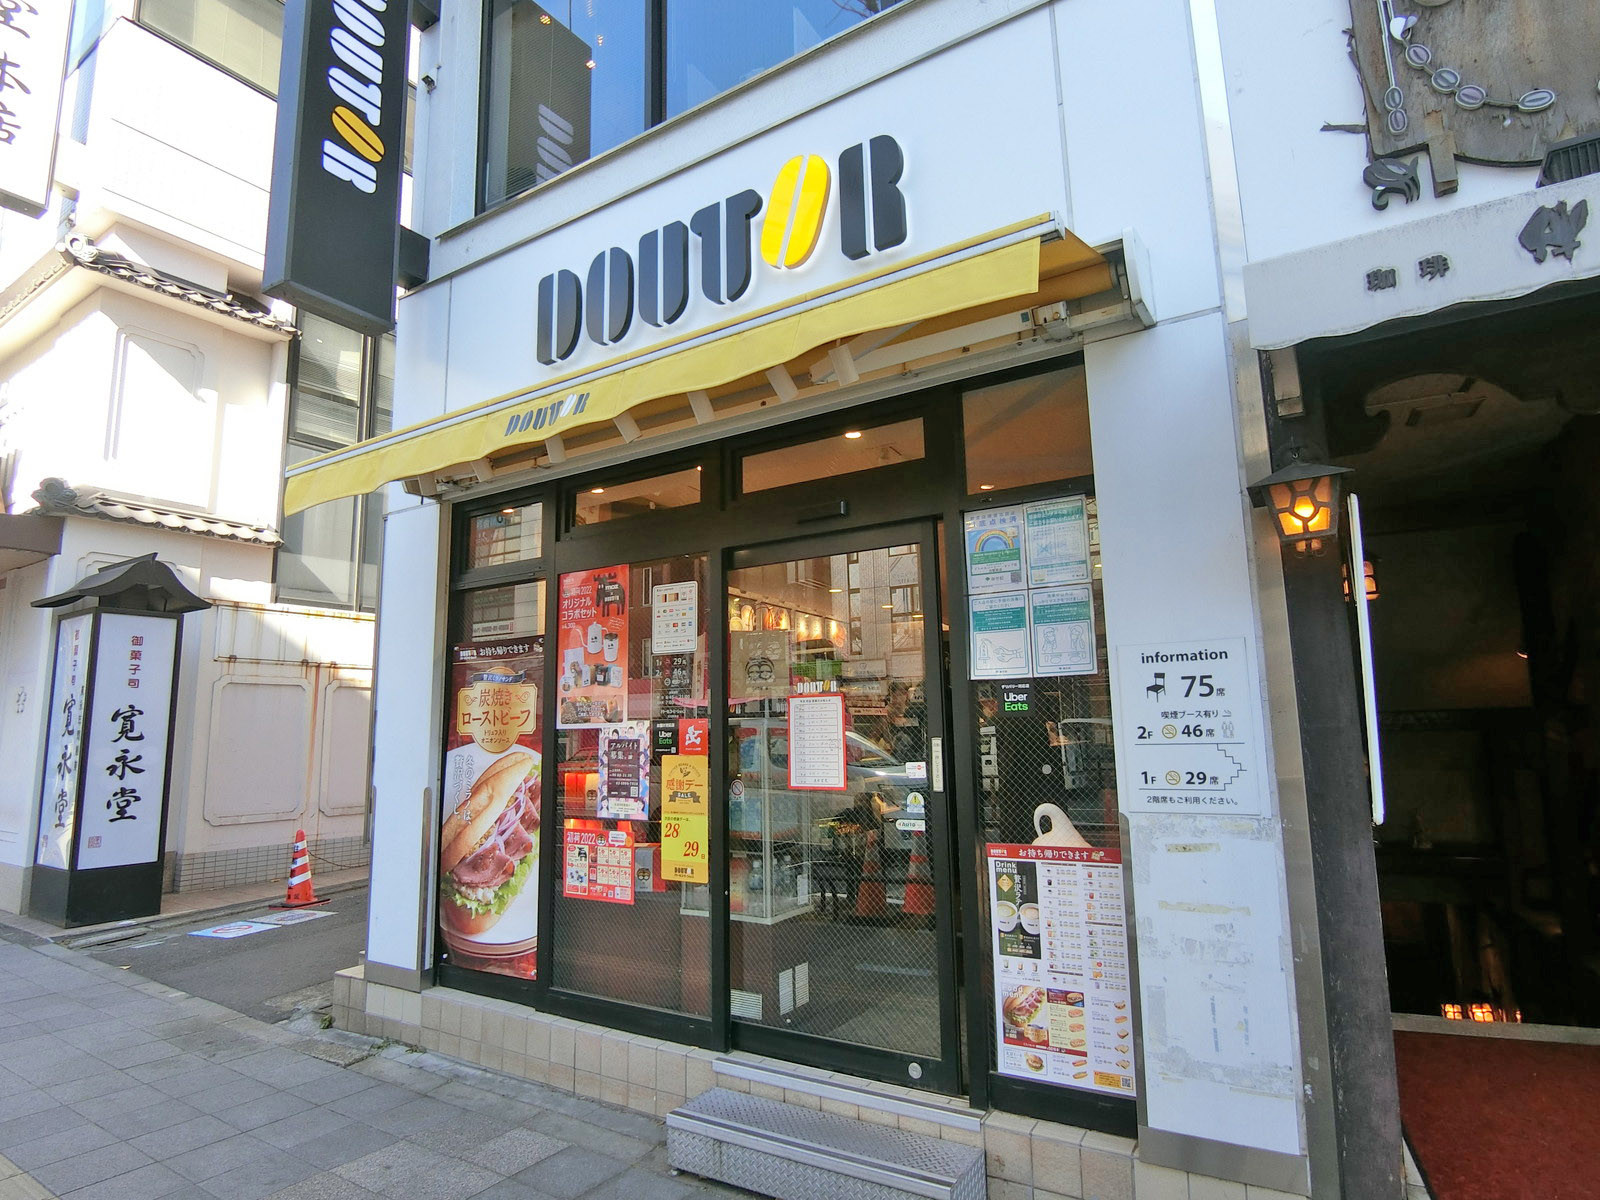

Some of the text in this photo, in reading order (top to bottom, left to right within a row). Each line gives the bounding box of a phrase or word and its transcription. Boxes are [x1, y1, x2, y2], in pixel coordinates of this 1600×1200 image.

[322, 0, 387, 194] OUTOR
[537, 134, 907, 366] DOUTOR
[504, 392, 590, 437] DOUTOR
[562, 596, 593, 609] オリジナル
[561, 607, 598, 620] コラボセット
[479, 643, 530, 657] お持ち帰りできます
[1141, 649, 1229, 664] information
[128, 635, 144, 689] 御菓子司
[796, 680, 837, 694] DOUTOR
[478, 688, 513, 708] 炭焼き
[1003, 692, 1028, 702] Uber
[1004, 702, 1029, 712] Eats
[461, 706, 532, 728] ローストビーフ
[1160, 709, 1219, 720] 喫煙ブース有り
[658, 730, 672, 738] Uber
[1136, 725, 1154, 740] 2F
[610, 742, 638, 750] アルバイト
[665, 778, 704, 791] 感謝デー
[1140, 771, 1158, 785] 1F
[664, 822, 681, 839] 28
[683, 841, 700, 858] 29
[1018, 848, 1089, 860] お持ち帰りできます
[995, 861, 1017, 869] Drink
